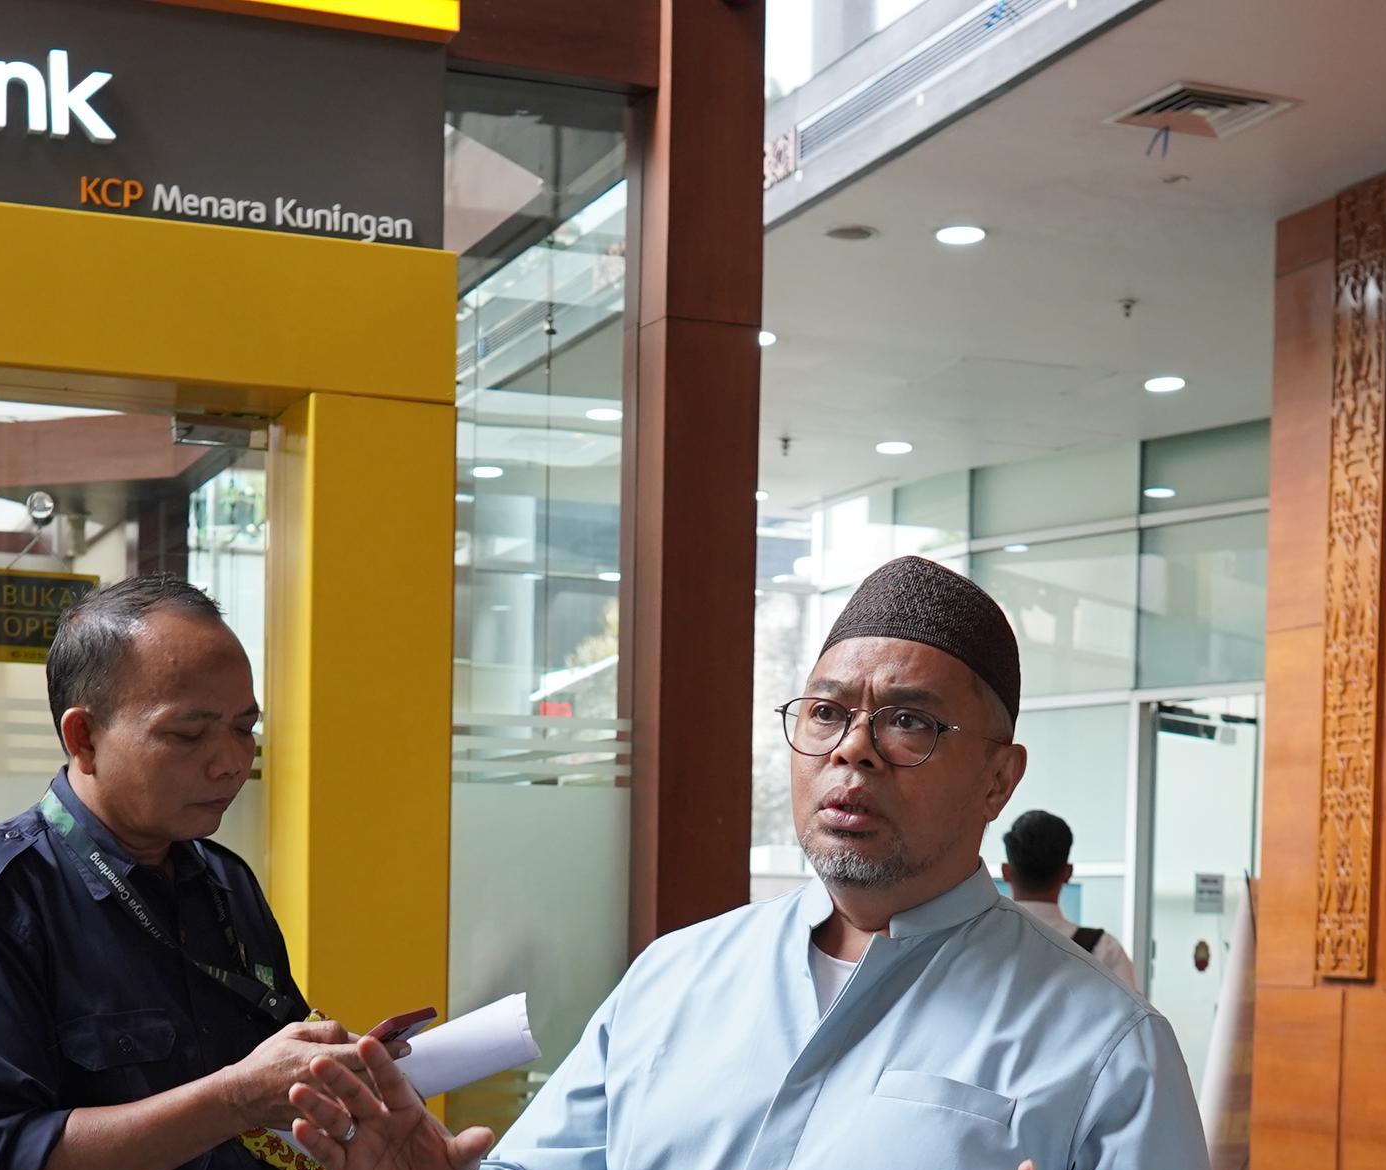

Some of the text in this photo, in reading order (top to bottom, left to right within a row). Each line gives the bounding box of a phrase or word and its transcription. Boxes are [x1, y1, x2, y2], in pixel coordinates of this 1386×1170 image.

[80, 176, 413, 243] KCP Menara Kuningan
[2, 583, 74, 608] BUKA
[3, 616, 56, 639] OPE
[89, 851, 131, 900] Cemerlang
[128, 899, 152, 928] Karya
